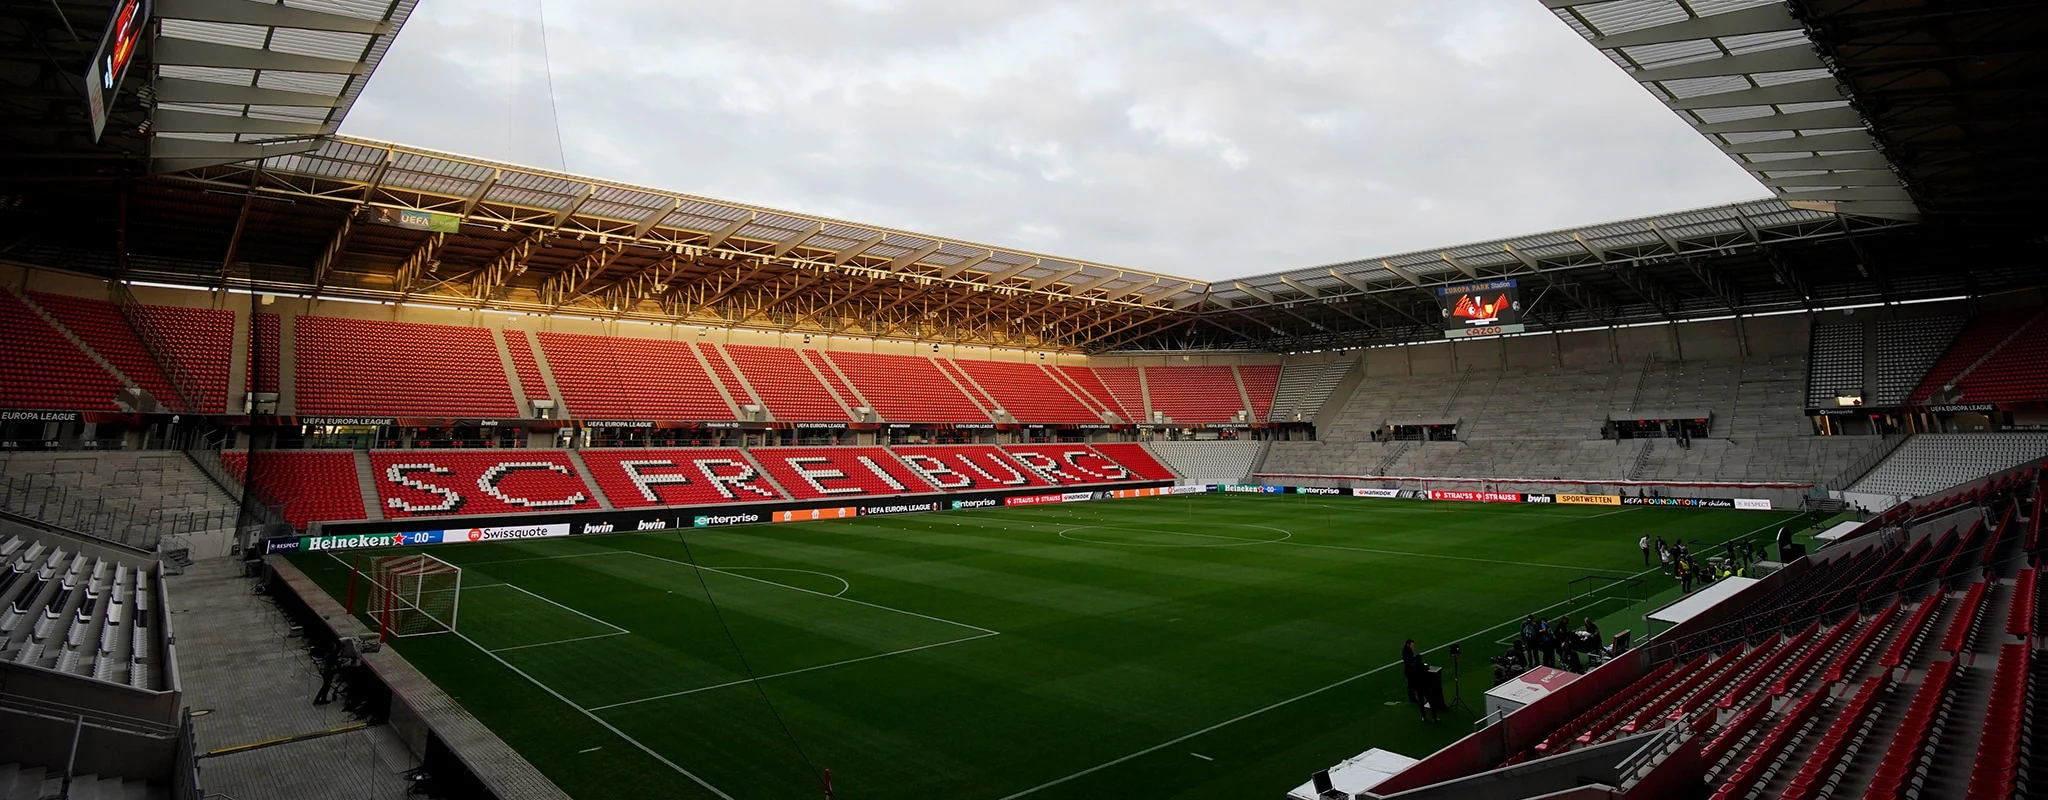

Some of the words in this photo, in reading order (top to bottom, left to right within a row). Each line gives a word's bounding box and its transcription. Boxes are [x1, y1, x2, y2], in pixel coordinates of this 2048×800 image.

[401, 215, 429, 225] UEFA
[1444, 286, 1470, 294] EUROPA
[1490, 281, 1511, 289] Stadion
[1465, 326, 1502, 336] CAZOO
[1, 412, 39, 420] EUROPA
[40, 413, 76, 421] LEAGUE
[386, 462, 588, 513] SC
[619, 452, 1130, 504] FREIBURG
[1224, 485, 1258, 493] Heineken
[1298, 487, 1340, 495] enterprise
[954, 498, 996, 508] enterprise
[1527, 494, 1551, 503] bwin
[1562, 495, 1612, 504] SPORTWETTEN
[1643, 497, 1697, 506] FOUNDATION
[1699, 499, 1707, 508] for
[1708, 499, 1731, 507] children
[868, 506, 884, 514] UEFA
[885, 505, 908, 513] EUROPA
[908, 503, 931, 511] LEAGUE
[637, 518, 666, 531] bwin
[696, 513, 759, 526] enterprise
[483, 526, 548, 540] Swissquote
[583, 521, 614, 534] bwin
[308, 535, 390, 551] Heineken
